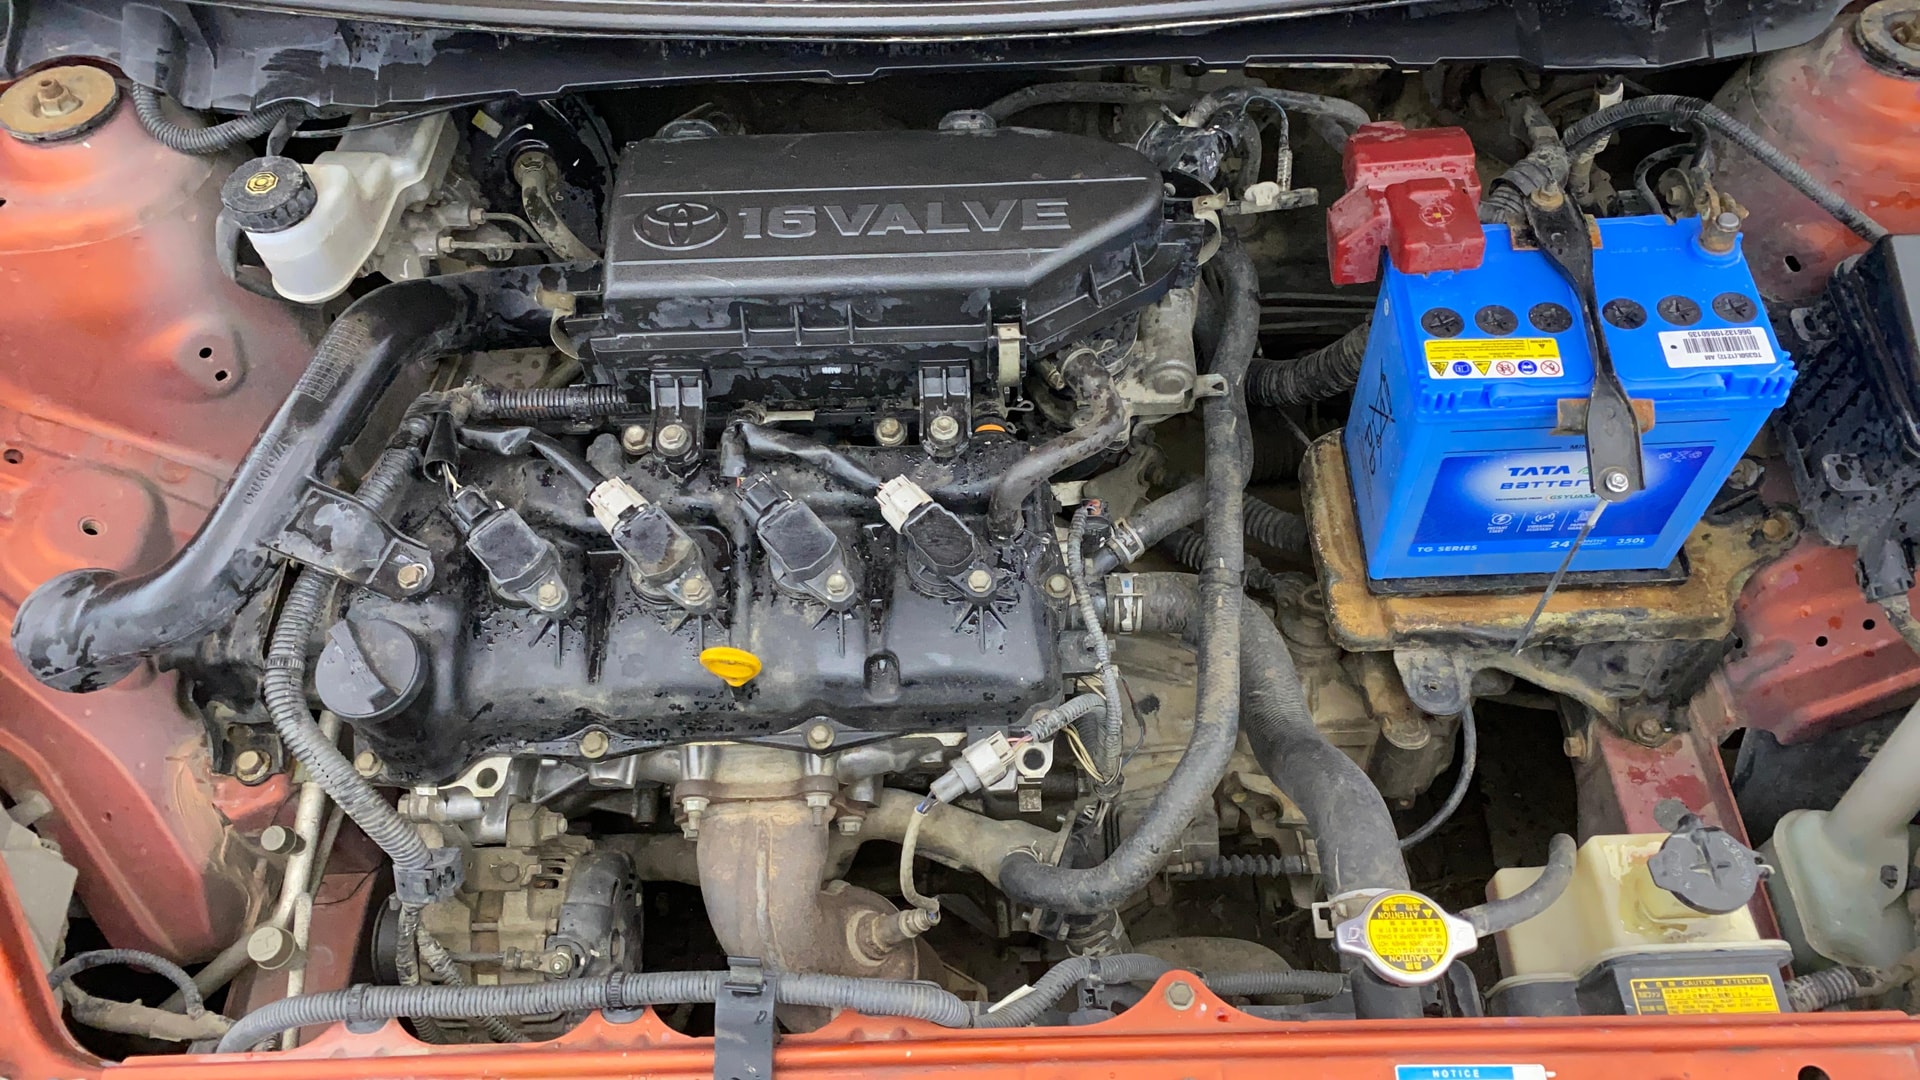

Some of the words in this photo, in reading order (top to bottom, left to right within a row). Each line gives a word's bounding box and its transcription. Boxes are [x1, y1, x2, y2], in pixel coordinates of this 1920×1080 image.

[1508, 465, 1570, 477] TATA
[1417, 545, 1433, 553] TG
[1437, 544, 1478, 552] SERIES
[1549, 540, 1571, 549] 24
[1722, 977, 1764, 985] ATTENTION
[1432, 1069, 1481, 1078] NOTICE
